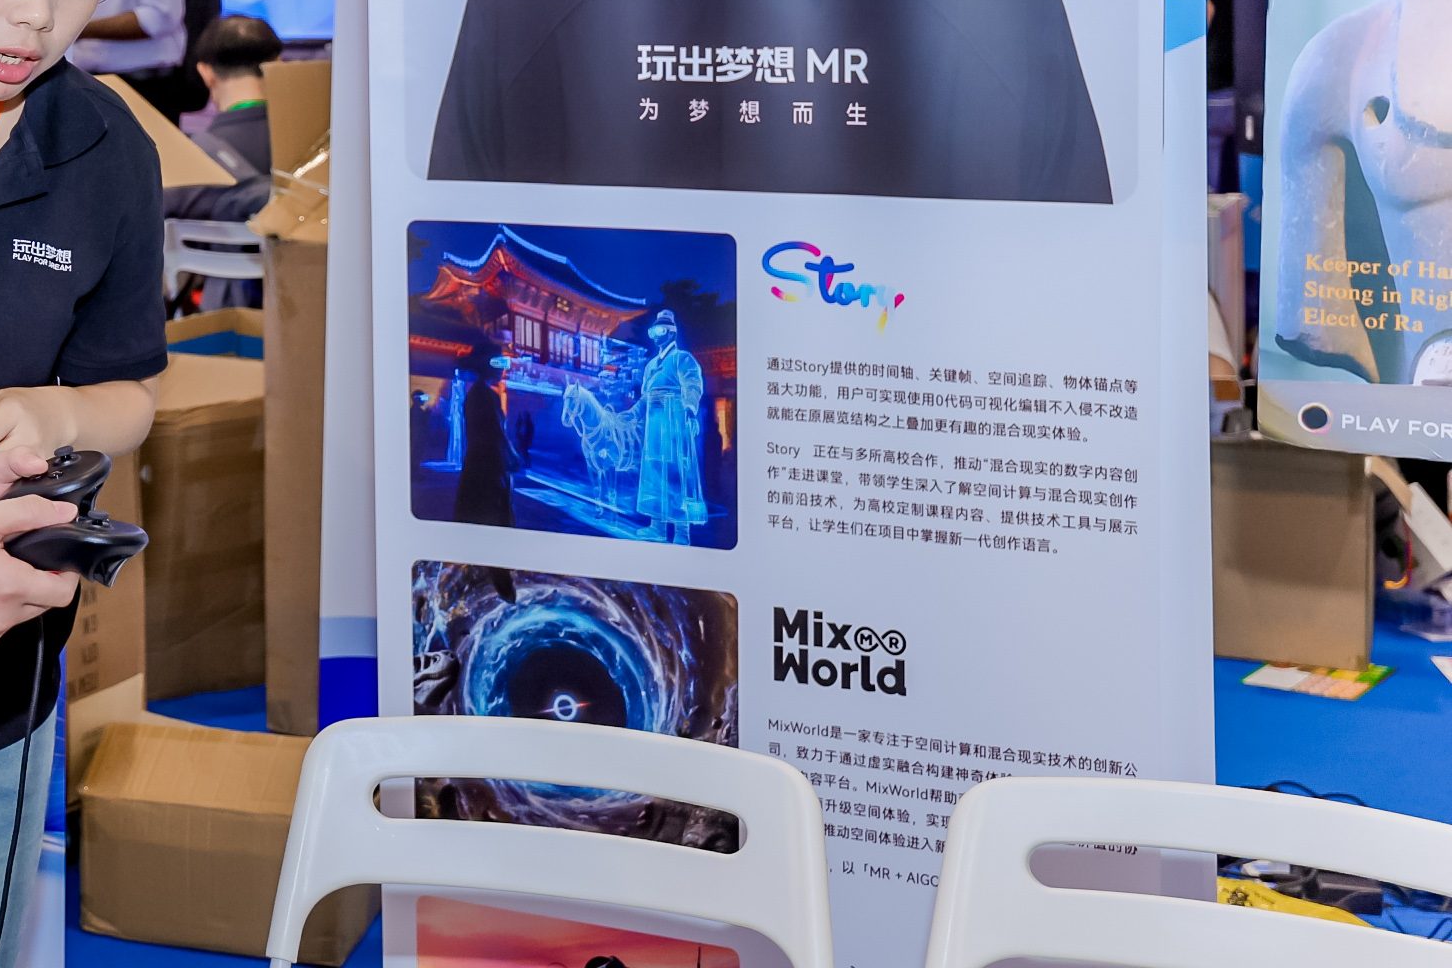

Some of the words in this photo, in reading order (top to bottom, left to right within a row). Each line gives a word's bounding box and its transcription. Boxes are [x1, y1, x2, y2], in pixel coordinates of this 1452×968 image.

[637, 45, 796, 83] 玩出梦想
[807, 47, 869, 84] MR
[12, 252, 32, 262] PLAY
[33, 257, 48, 266] FOR
[13, 238, 72, 264] 玩出梦想
[1306, 253, 1381, 277] Keeper
[1387, 260, 1412, 277] of
[1418, 261, 1452, 280] Ha
[1304, 281, 1374, 306] Strong
[1382, 286, 1401, 303] in
[1411, 288, 1452, 312] Rig
[1304, 307, 1358, 328] Elect
[1364, 313, 1388, 330] of
[1394, 314, 1424, 333] Ra
[1342, 414, 1400, 433] PLAY
[1408, 420, 1452, 439] FOR
[766, 441, 800, 459] Story
[773, 606, 852, 651] Mix
[773, 645, 907, 696] World
[768, 742, 1012, 783] 司，致力于通过虚实融合构建神奇体
